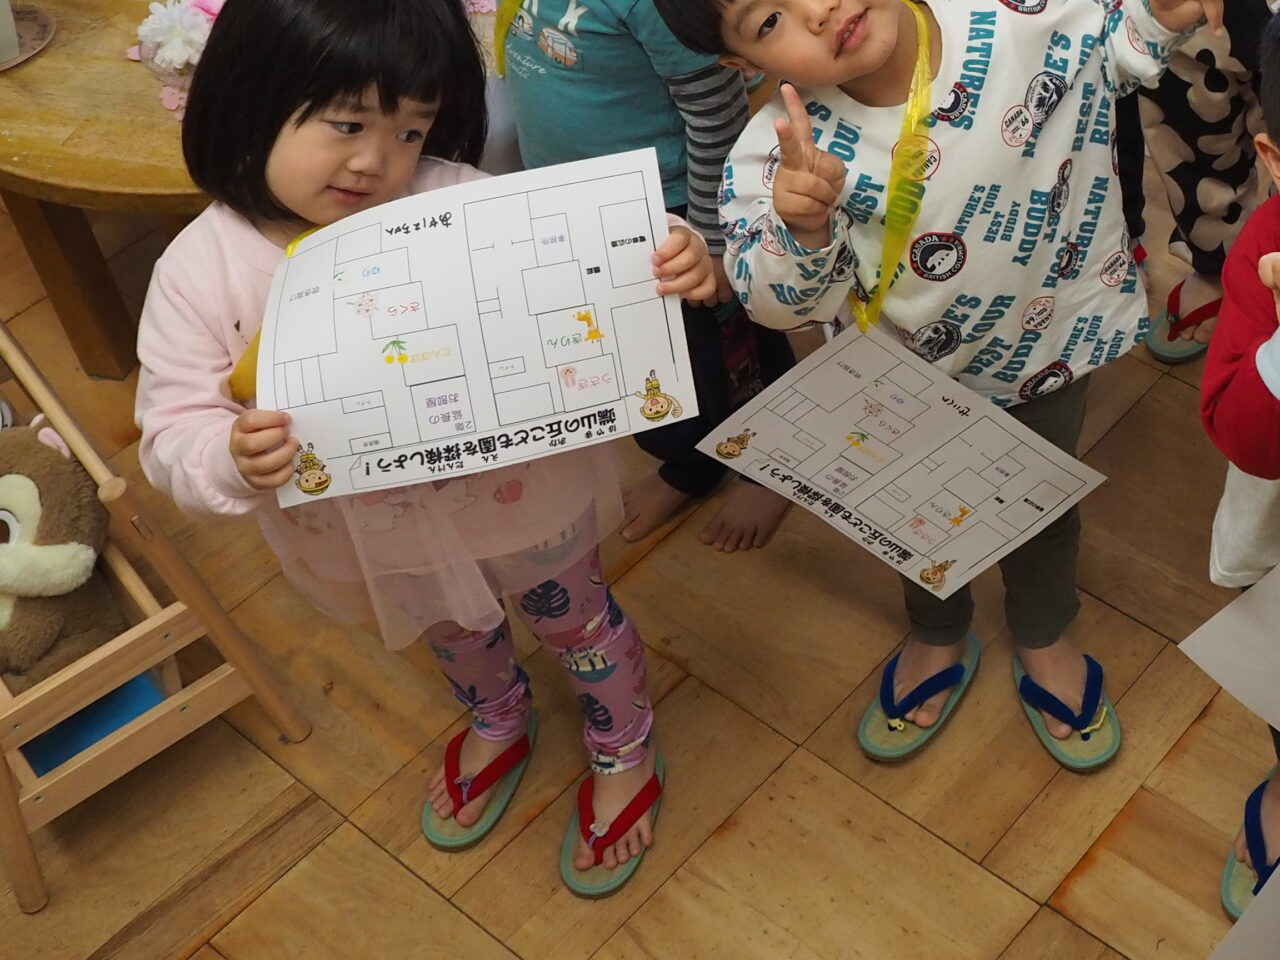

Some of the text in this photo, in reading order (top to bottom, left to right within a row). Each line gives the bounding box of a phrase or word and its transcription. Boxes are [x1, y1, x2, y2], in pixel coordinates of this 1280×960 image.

[983, 210, 1006, 244] BEST
[1000, 200, 1022, 242] BUDDY
[362, 265, 380, 278] ゆり
[289, 286, 320, 302] 吹き抜け
[387, 301, 420, 316] さくら
[1083, 315, 1104, 343] YOUR
[547, 333, 582, 348] きりん
[962, 336, 1013, 377] BEST
[577, 373, 612, 391] うさぎ
[425, 393, 460, 408] お部屋
[428, 410, 463, 425] 延長の
[584, 424, 617, 439] はやま
[365, 408, 617, 476] 端山の丘こども園を探検しよう！
[549, 437, 567, 448] おか
[482, 453, 499, 464] えん
[427, 461, 464, 474] たんけん
[759, 463, 915, 563] 端山の丘こども園を探検しよう！
